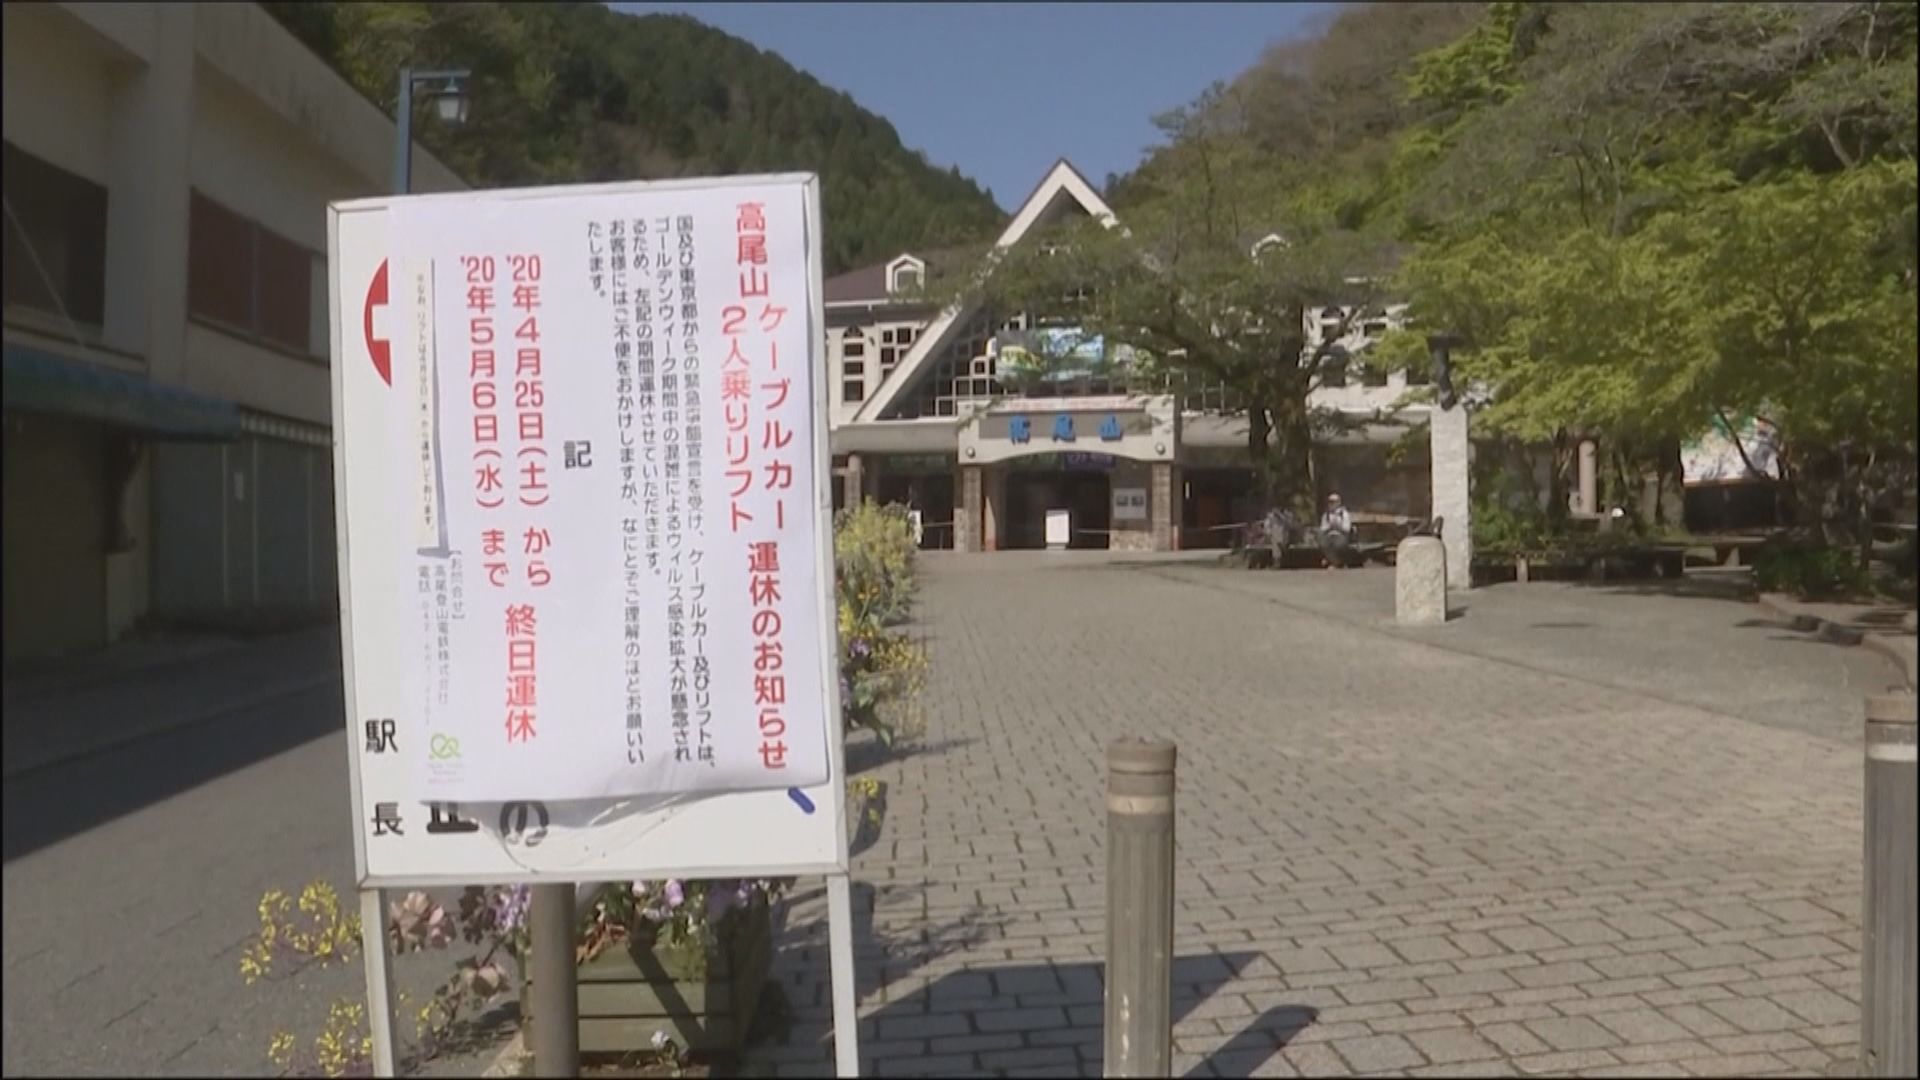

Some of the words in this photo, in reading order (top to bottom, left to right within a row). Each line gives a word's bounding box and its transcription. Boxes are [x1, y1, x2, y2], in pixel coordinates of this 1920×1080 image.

[587, 220, 606, 298] たします。
[735, 201, 769, 298] 高尾山
[563, 440, 593, 470] 記
[720, 304, 755, 532] 2人乗りリフト
[759, 303, 793, 531] ケーブルカー
[504, 603, 538, 744] 終日運休
[747, 542, 788, 770] 運休のお知らせ
